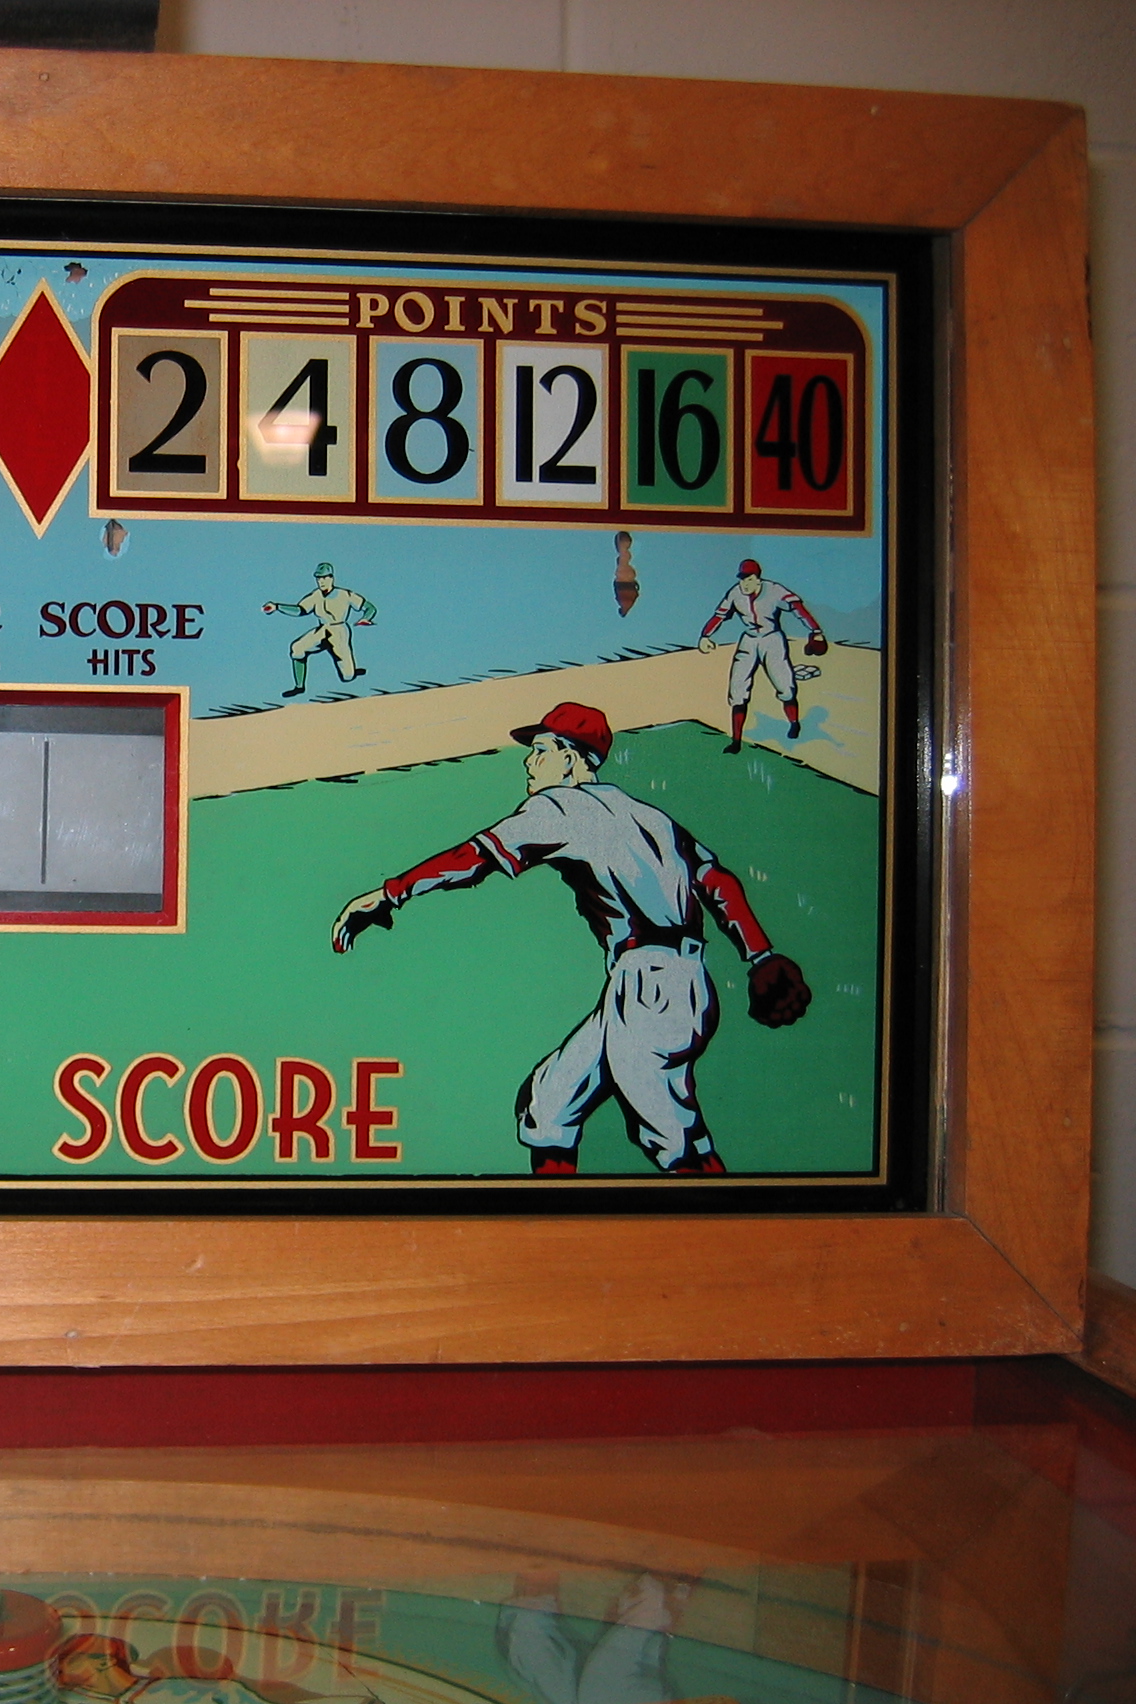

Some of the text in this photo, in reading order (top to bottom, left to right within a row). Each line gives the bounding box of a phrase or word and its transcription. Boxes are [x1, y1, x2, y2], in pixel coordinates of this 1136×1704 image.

[355, 293, 608, 335] POINTS
[127, 350, 843, 491] 2 4 8 12 16 40
[39, 600, 205, 640] SCORE
[86, 649, 157, 677] HITS
[51, 1052, 404, 1165] SCORE
